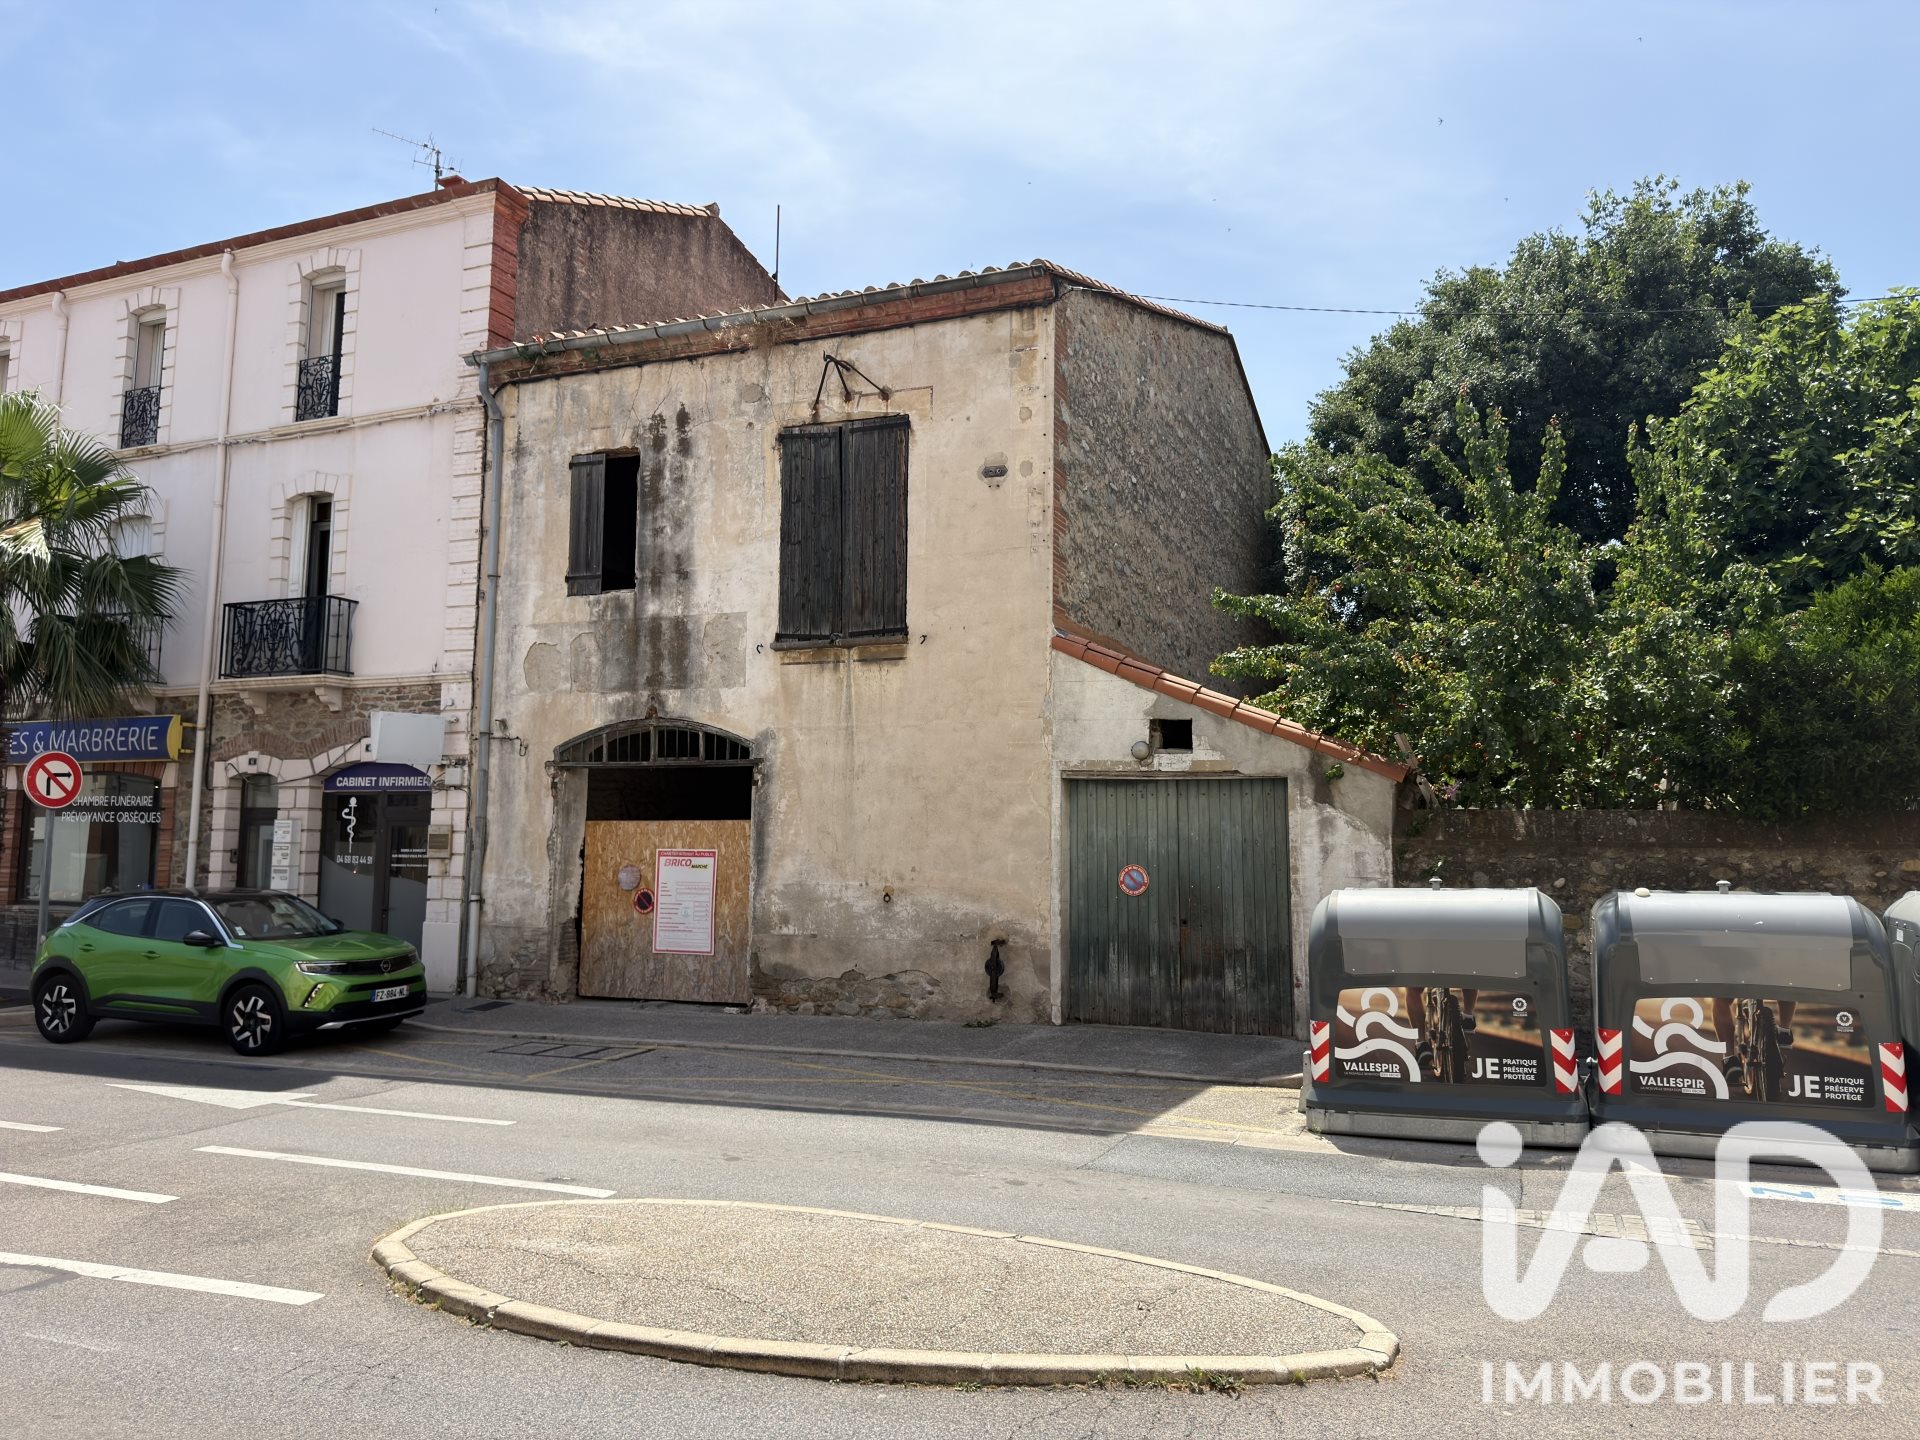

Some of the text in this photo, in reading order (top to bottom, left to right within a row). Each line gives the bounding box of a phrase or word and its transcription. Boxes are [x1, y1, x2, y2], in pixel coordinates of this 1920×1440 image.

[33, 731, 44, 753] &
[50, 726, 159, 752] MARBRERIE
[336, 777, 377, 787] CABINET
[72, 795, 153, 807] CHAMBRE FUNÉRAIRE
[61, 811, 161, 824] PRÉVOYANCE OBSÈQUES
[664, 858, 692, 867] BRICO
[1343, 1061, 1400, 1073] VALLESPIR
[1502, 1058, 1538, 1067] PRATIQUE
[1471, 1057, 1501, 1079] JE
[1503, 1065, 1538, 1074] PRÉSERVE
[1503, 1072, 1536, 1081] PROTÈGE
[1824, 1076, 1865, 1086] PRATIQUE
[1639, 1075, 1705, 1089] VALLESPIR
[1787, 1074, 1822, 1099] JE
[1824, 1084, 1865, 1094] PRÉSERVE
[1825, 1092, 1863, 1101] PROTÈGE
